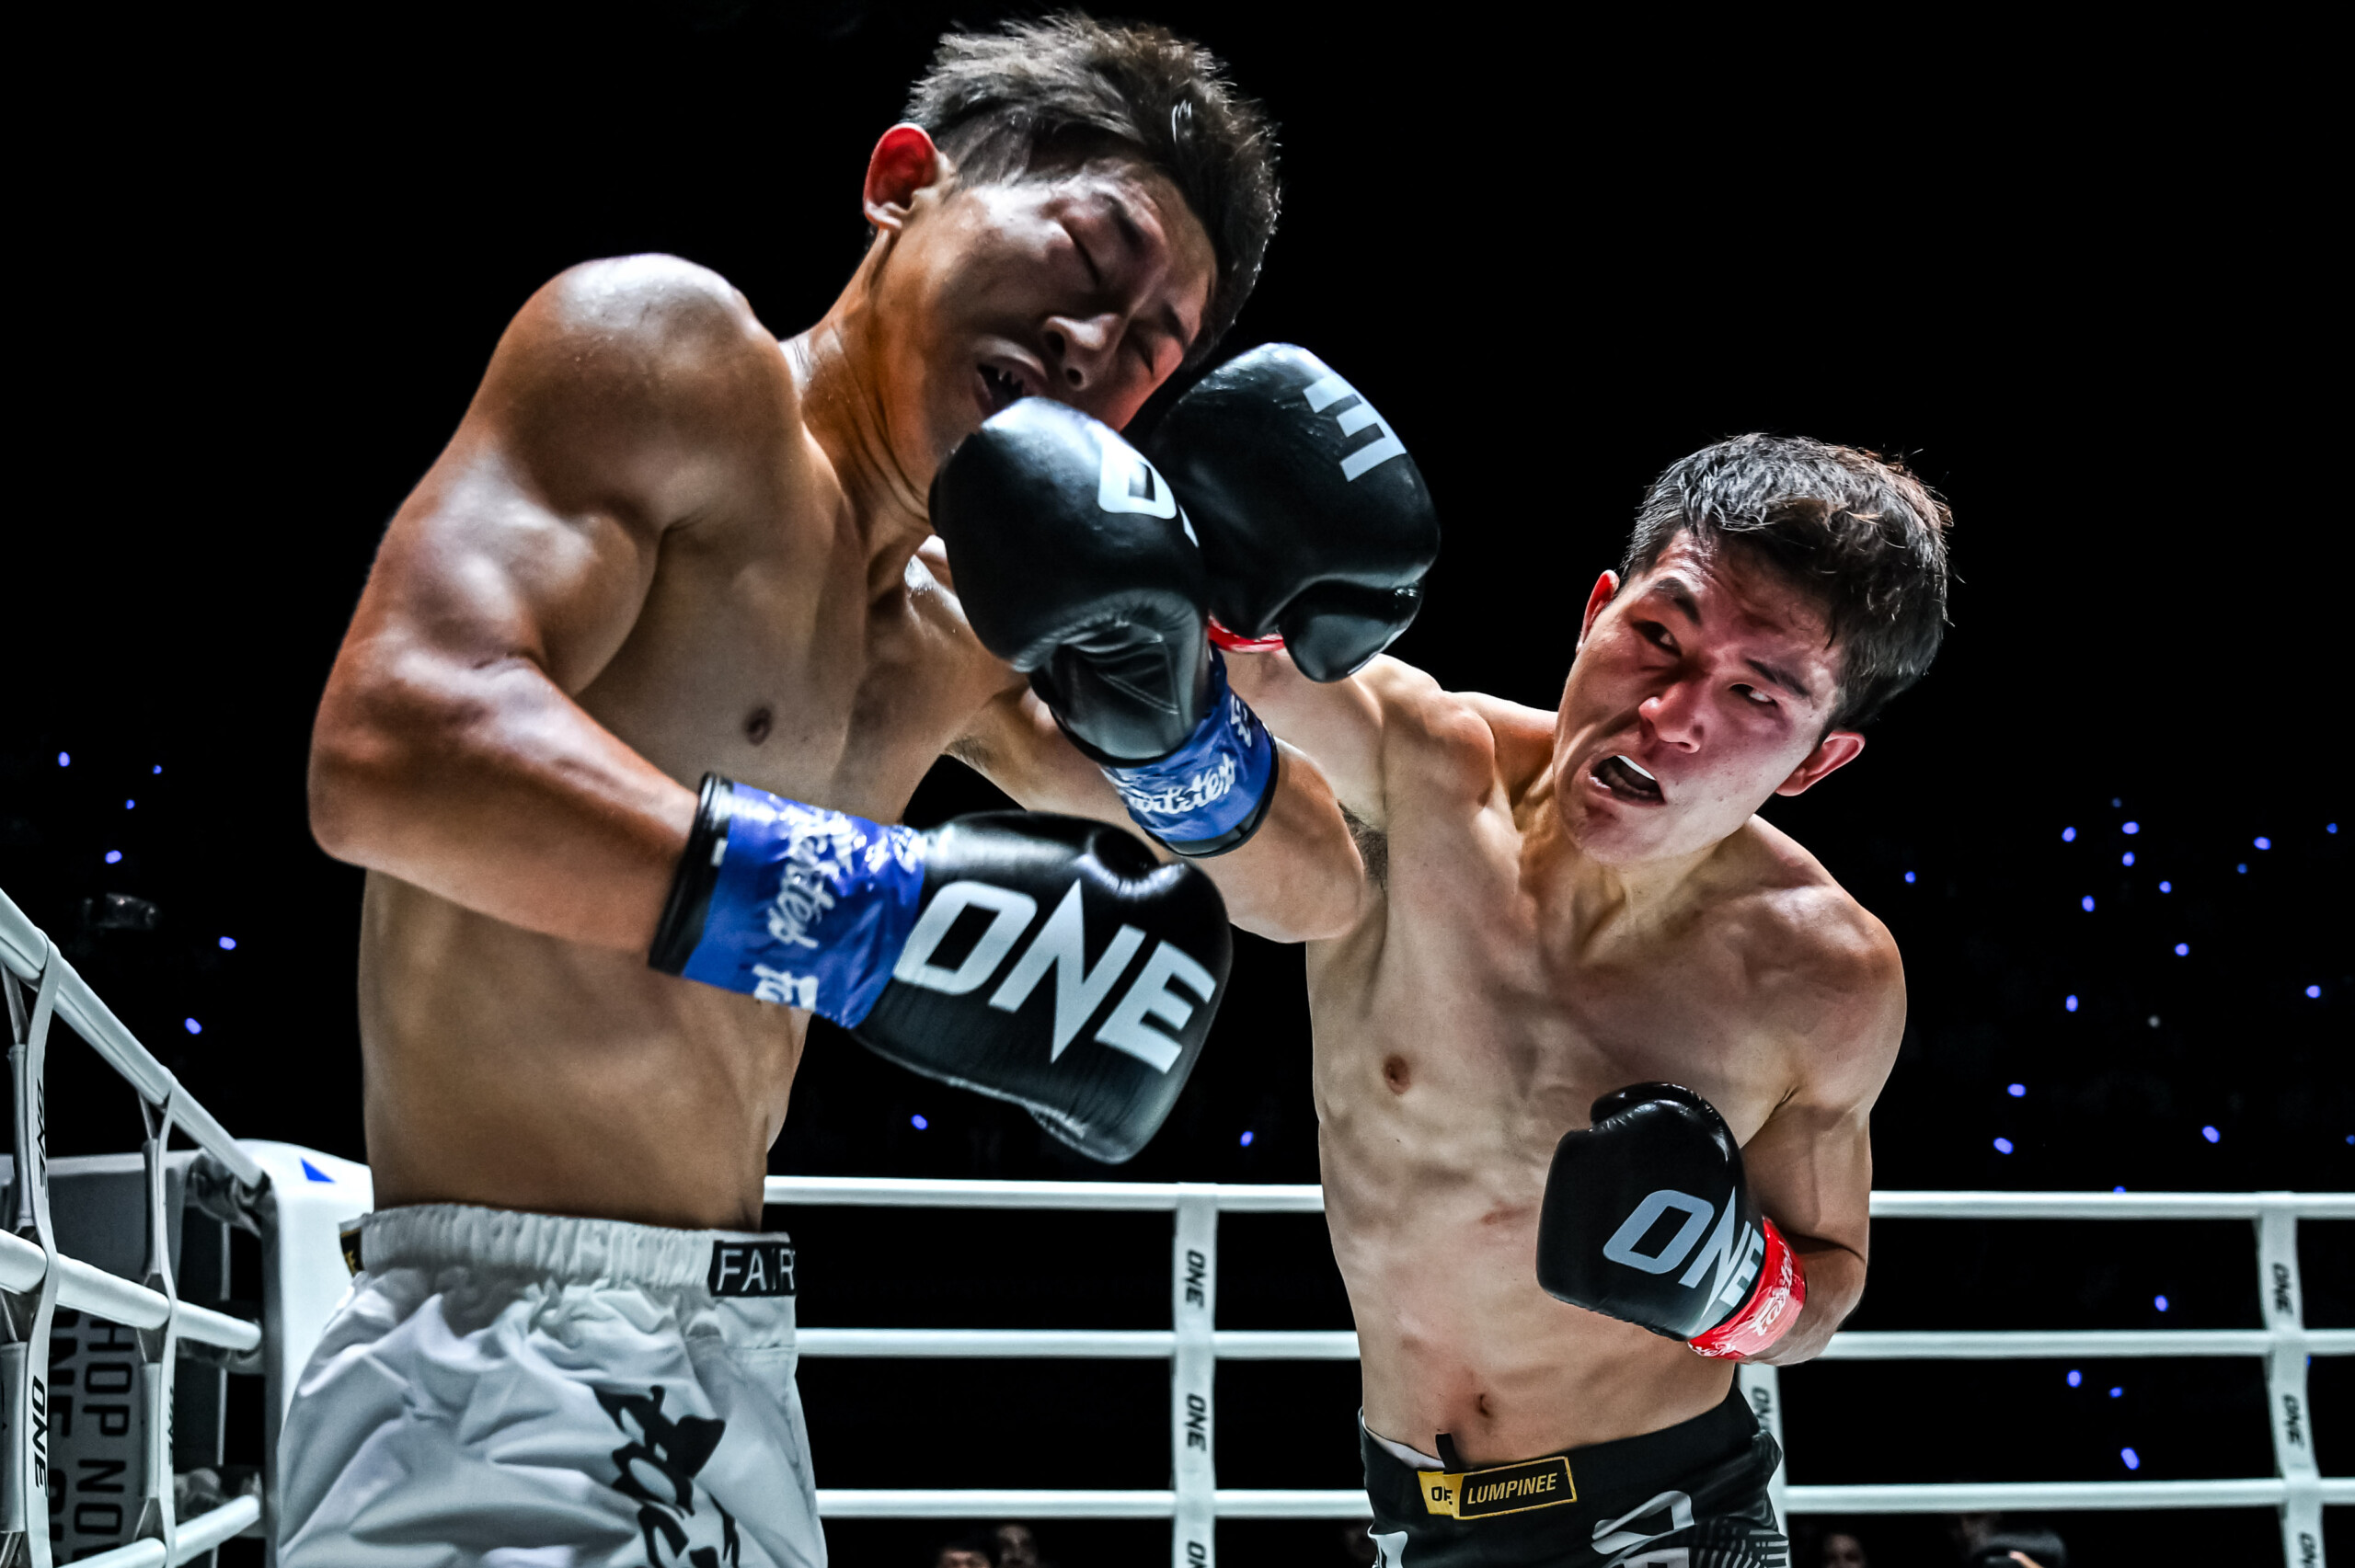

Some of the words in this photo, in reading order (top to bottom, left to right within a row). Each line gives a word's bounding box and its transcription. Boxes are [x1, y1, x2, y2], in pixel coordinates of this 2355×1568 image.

[893, 878, 1215, 1074] ONE
[717, 1249, 796, 1291] FAIR
[1185, 1249, 1207, 1309] ONE
[1603, 1185, 1764, 1319] ONE
[2271, 1263, 2293, 1315] ONE
[32, 1375, 49, 1498] ONE
[1185, 1393, 1209, 1451] ONE
[2282, 1393, 2305, 1448] ONE
[1467, 1472, 1558, 1505] LUMPINEE
[1186, 1540, 1208, 1568] ON
[2298, 1531, 2317, 1568] ON
